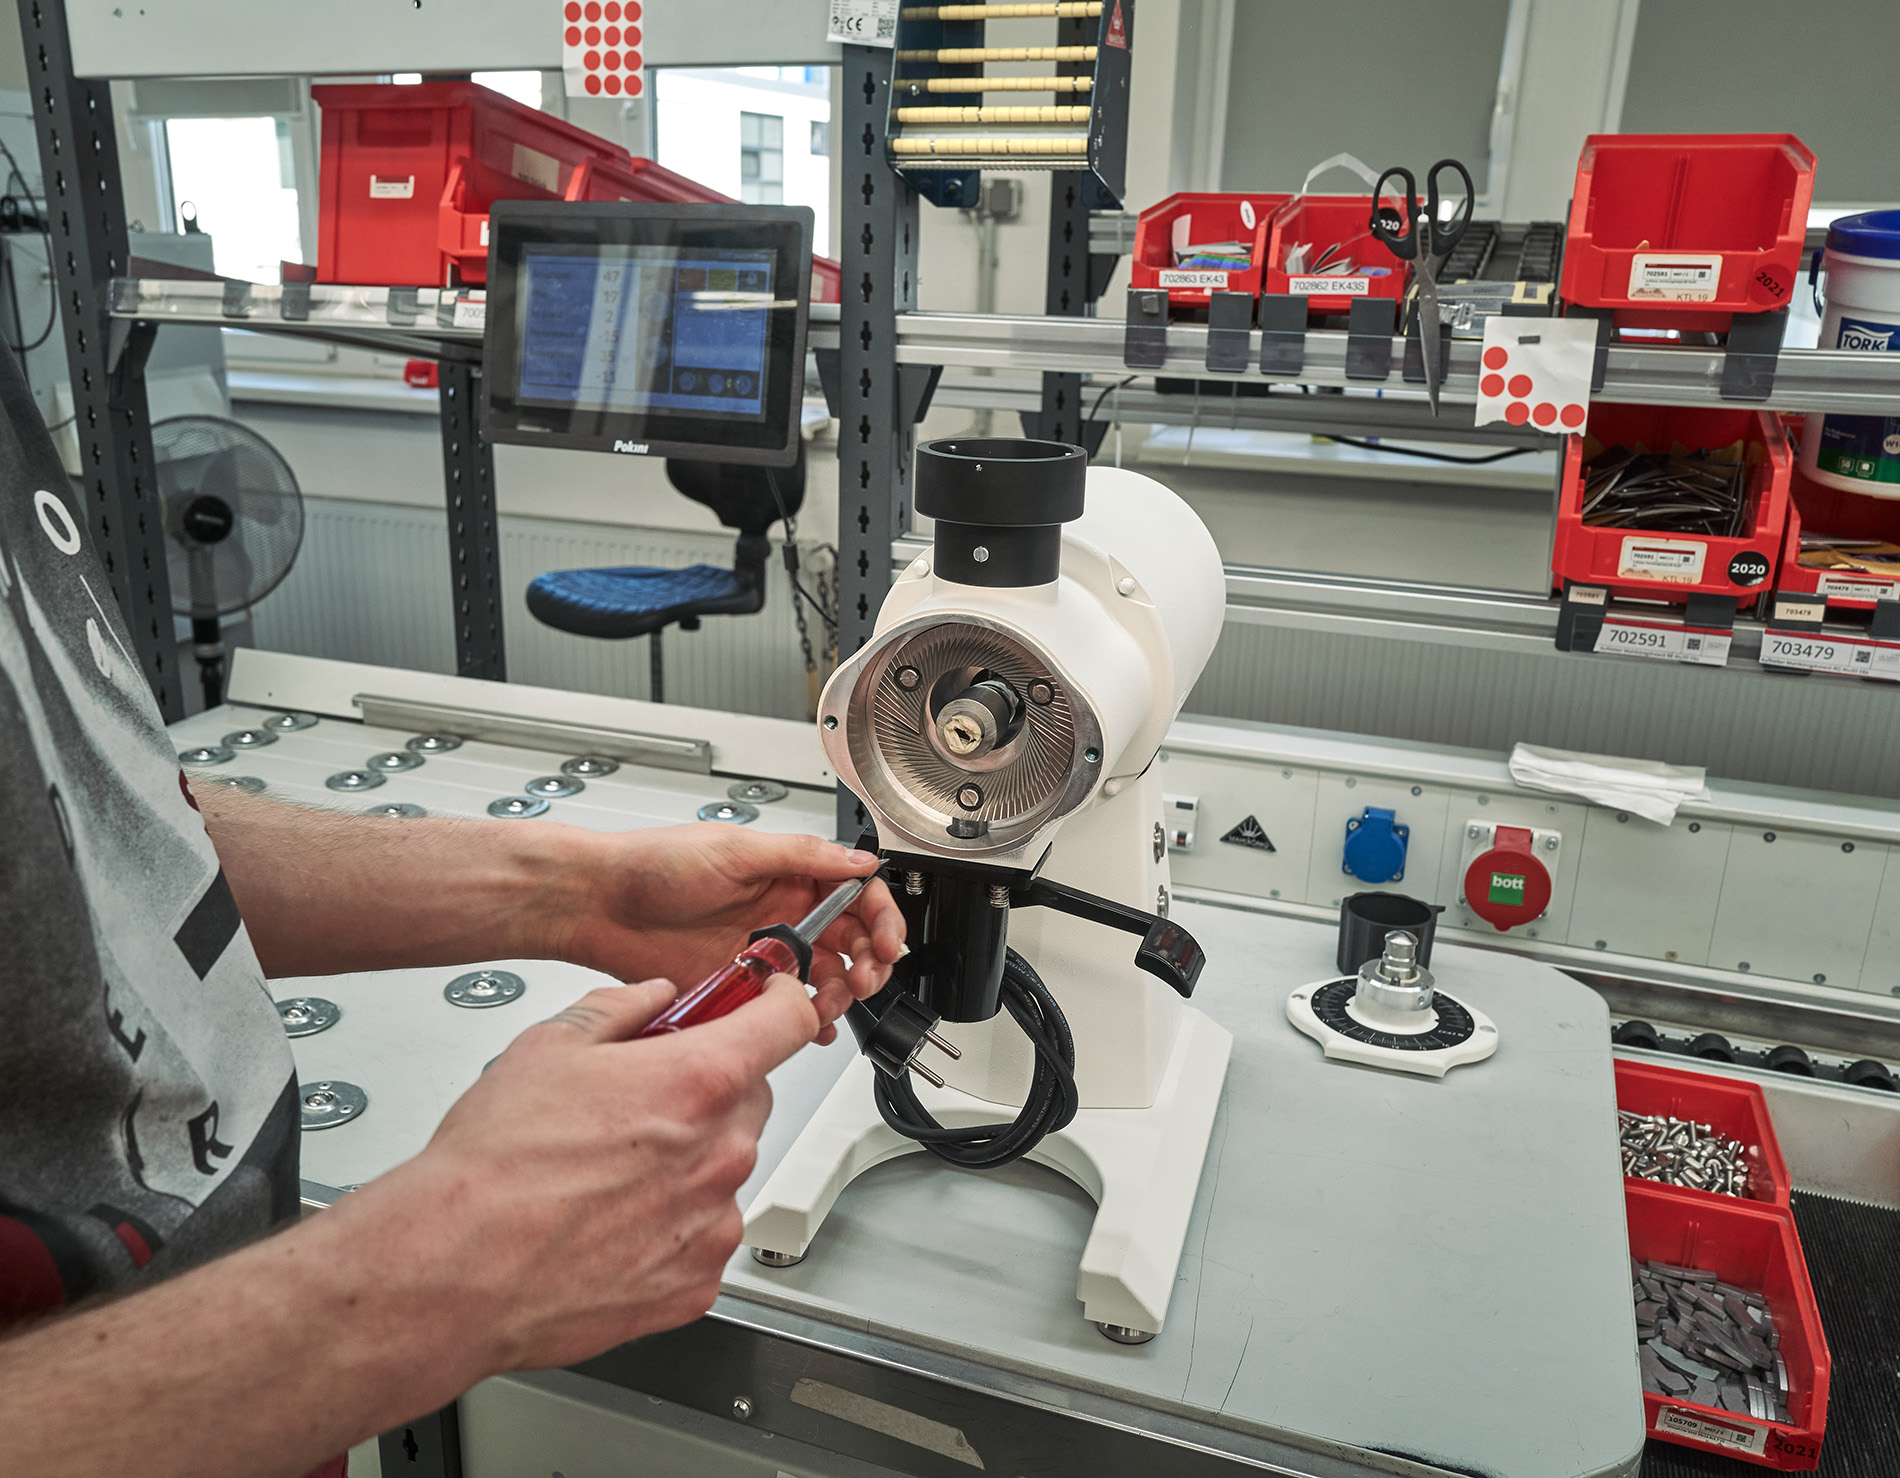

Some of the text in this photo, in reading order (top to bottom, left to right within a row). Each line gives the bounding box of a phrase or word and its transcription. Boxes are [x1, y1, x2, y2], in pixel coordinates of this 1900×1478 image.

[1163, 273, 1225, 285] 702863 EK43
[1293, 280, 1365, 292] 702862 EK43S
[1756, 272, 1785, 298] 2021
[1843, 333, 1885, 350] TORK
[613, 439, 649, 454] Pokini
[1731, 563, 1766, 576] 2020
[1785, 608, 1811, 616] 703479
[1610, 629, 1666, 647] 702591
[1772, 640, 1834, 660] 703479
[1493, 875, 1524, 890] bott
[1668, 1416, 1698, 1429] 105709
[1773, 1438, 1817, 1460] 2021
